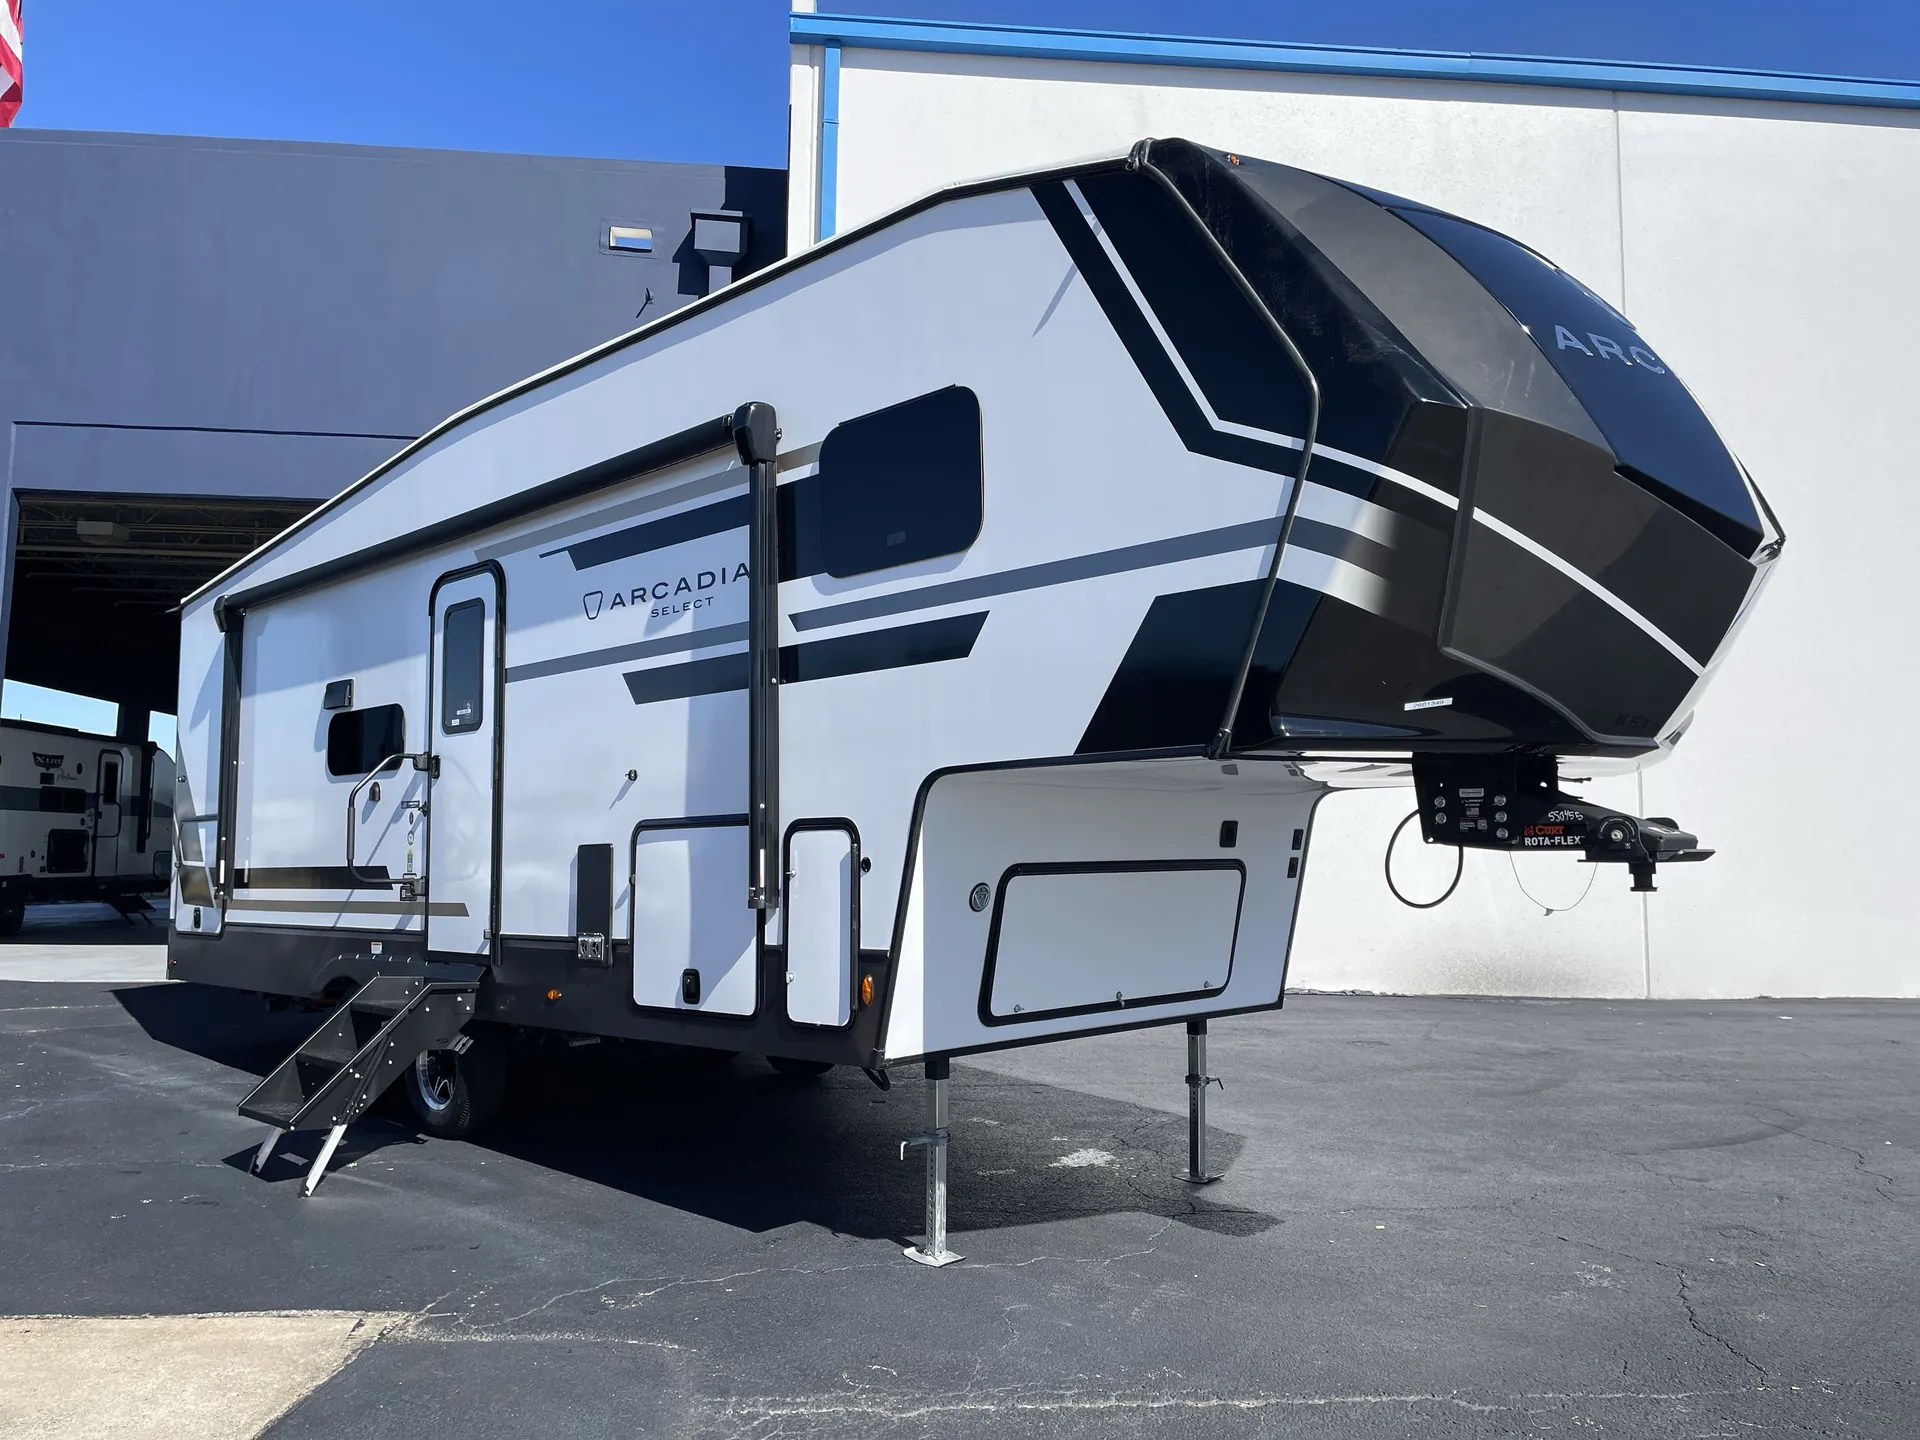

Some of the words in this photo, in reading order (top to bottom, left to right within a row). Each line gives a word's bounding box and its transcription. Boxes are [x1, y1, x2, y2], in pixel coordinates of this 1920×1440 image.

[609, 562, 750, 611] ARCADIA
[650, 596, 714, 618] SELECT
[1535, 824, 1565, 836] CURT
[1524, 836, 1582, 847] ROTA-FLEX
